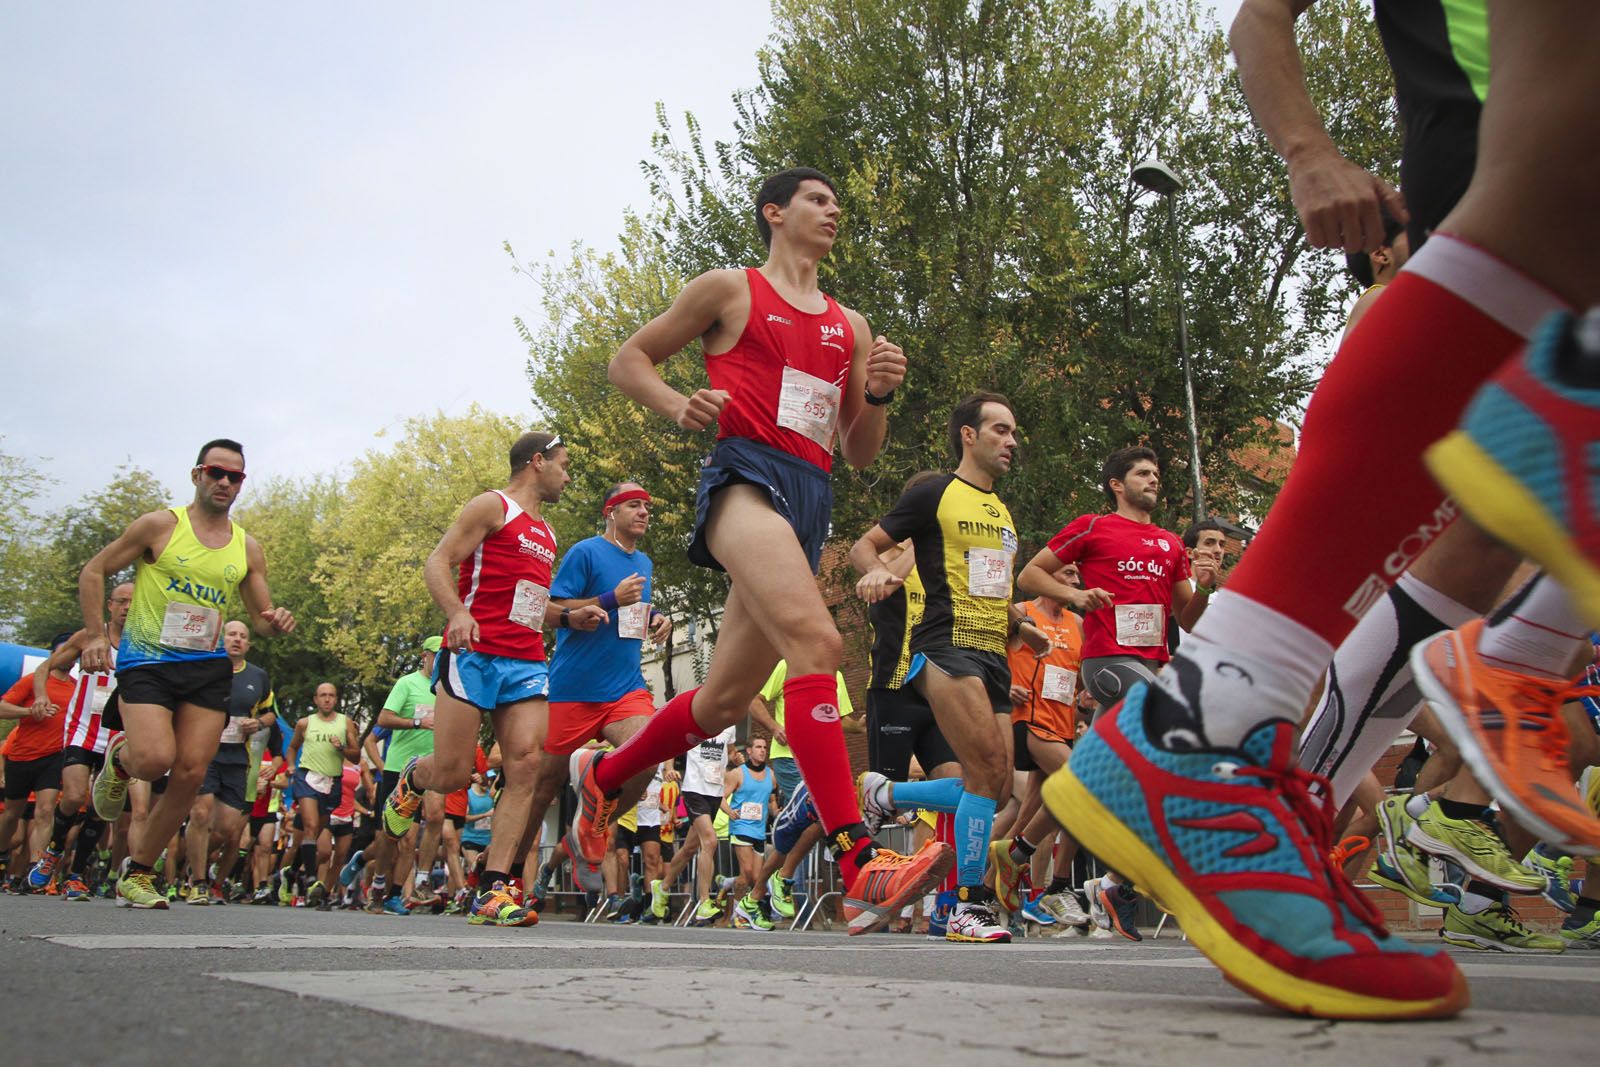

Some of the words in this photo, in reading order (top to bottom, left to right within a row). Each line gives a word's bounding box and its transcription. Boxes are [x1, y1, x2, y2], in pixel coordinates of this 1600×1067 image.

[803, 400, 826, 419] 659
[1384, 495, 1457, 577] COMP
[983, 555, 1006, 570] Jorge
[1117, 556, 1144, 572] sóc
[986, 569, 1003, 580] 677
[1127, 610, 1154, 621] Carlos
[182, 623, 202, 634] 449
[1134, 621, 1149, 631] 671
